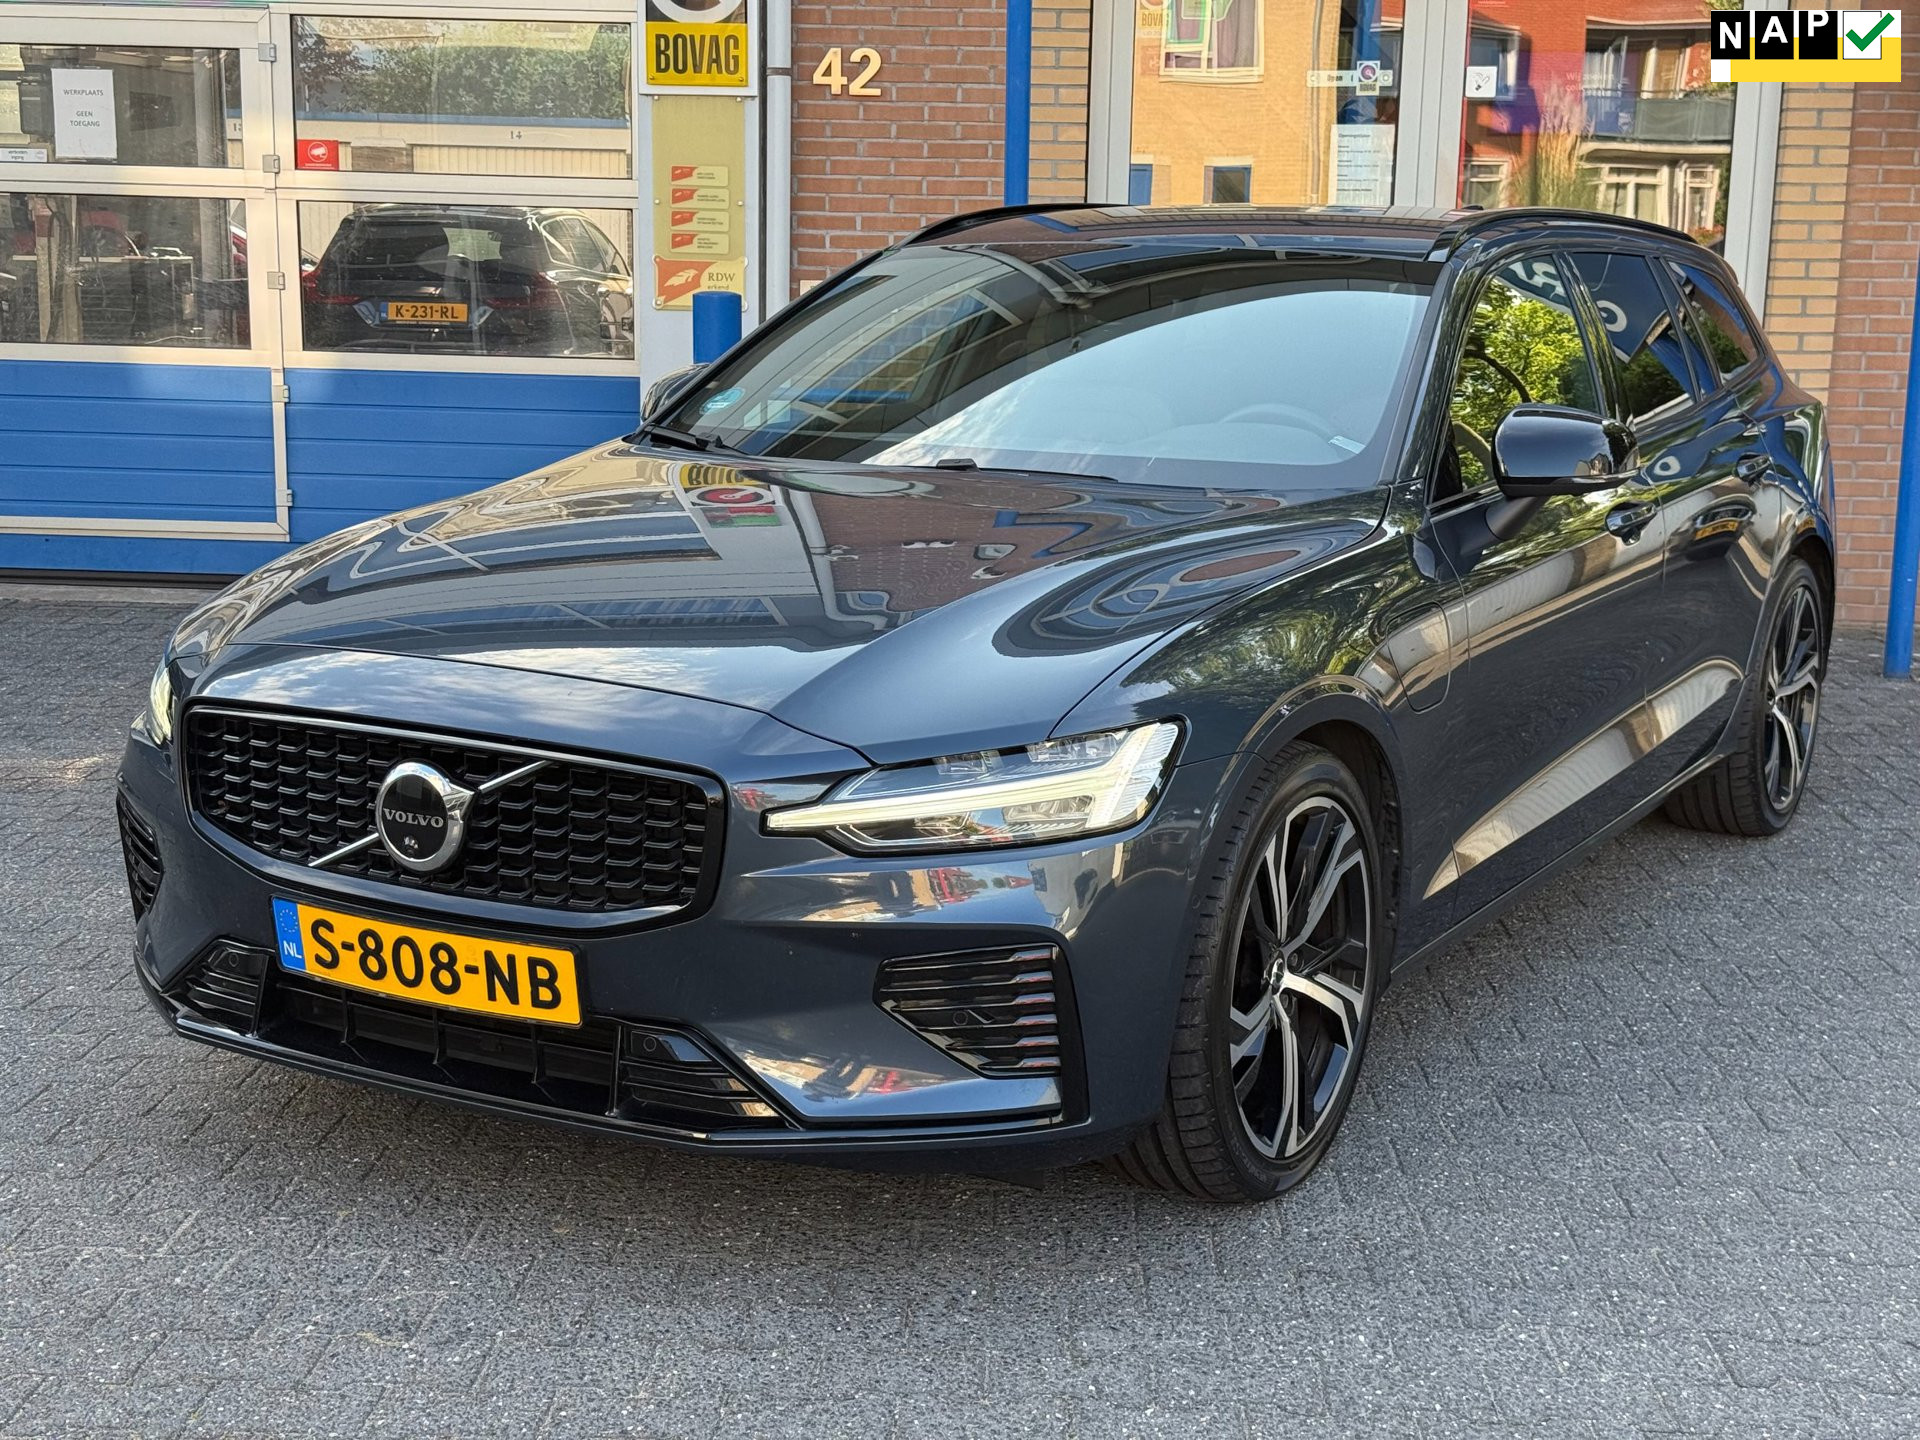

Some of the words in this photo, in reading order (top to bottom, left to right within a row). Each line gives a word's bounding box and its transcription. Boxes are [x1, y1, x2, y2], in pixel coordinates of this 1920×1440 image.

[1141, 12, 1169, 27] BOVA
[655, 33, 740, 75] BOVAG
[812, 47, 882, 96] 42
[510, 130, 523, 140] 14
[707, 272, 736, 282] RDW
[395, 305, 459, 319] K-231-RL
[383, 808, 444, 828] VOLVO
[283, 940, 302, 959] NL
[310, 918, 562, 1010] S-808-NB
